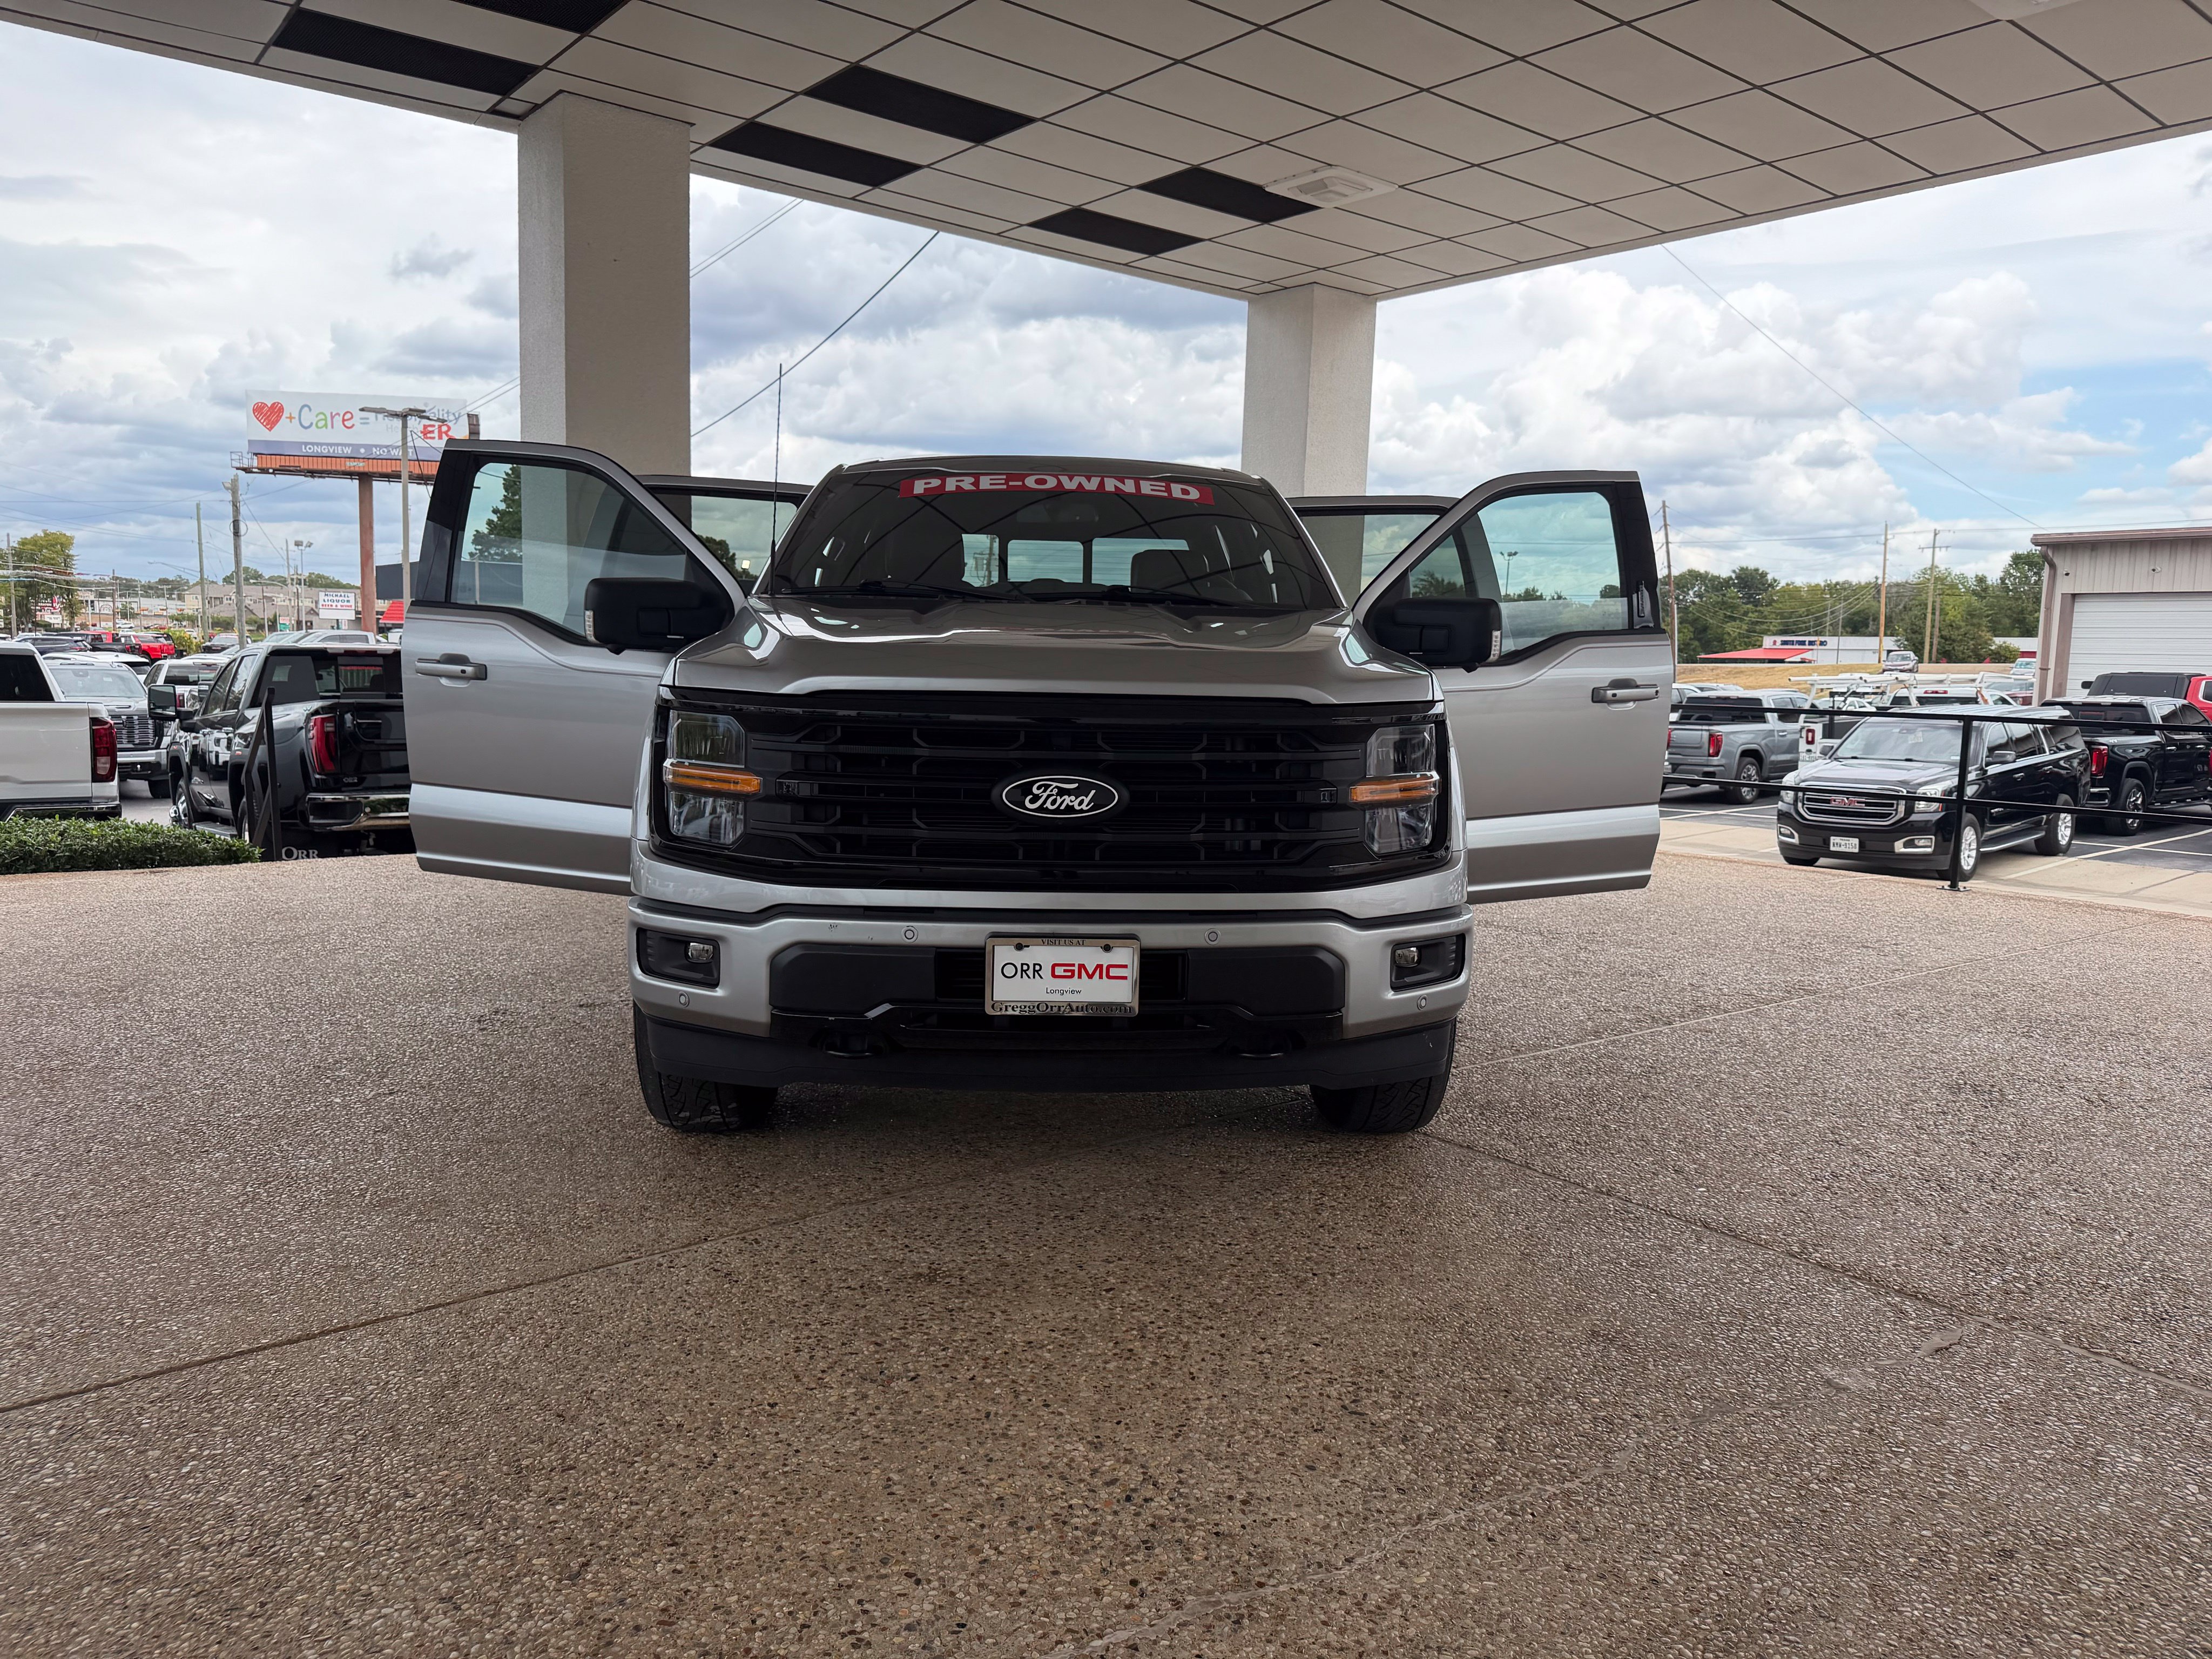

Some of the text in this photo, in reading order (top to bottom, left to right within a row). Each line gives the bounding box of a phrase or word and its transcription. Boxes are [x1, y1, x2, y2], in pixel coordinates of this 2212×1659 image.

[298, 404, 355, 430] Care
[421, 423, 456, 440] ER
[302, 444, 352, 454] LONGVIEW
[373, 447, 388, 455] NO
[913, 475, 1201, 501] PRE-OWNED
[1024, 781, 1096, 811] Ford
[1830, 797, 1866, 808] GMC
[1001, 962, 1128, 980] ORR GMC
[1046, 987, 1082, 996] Longview
[991, 1002, 1132, 1015] GreggOrrAuto.com
